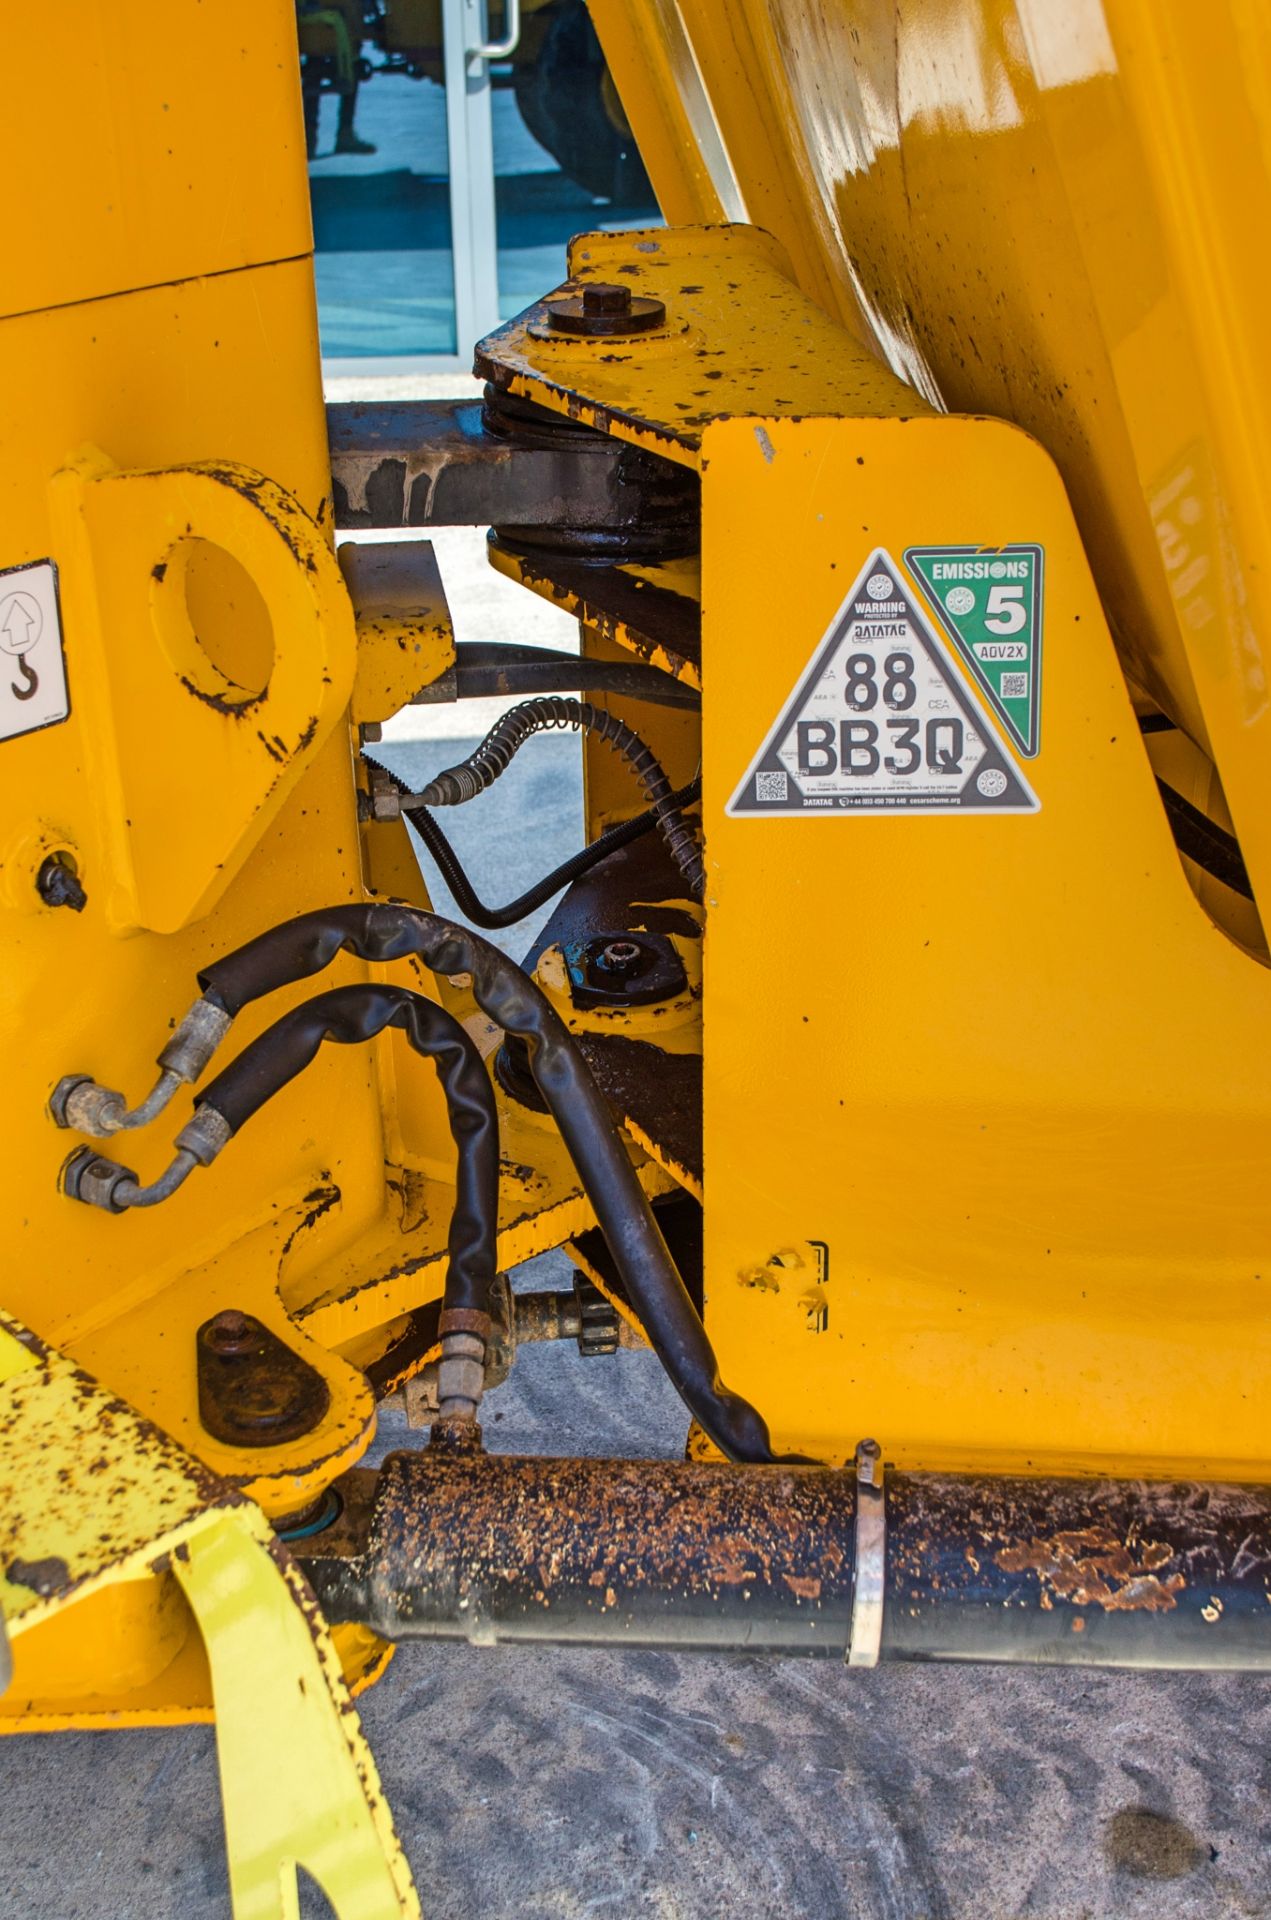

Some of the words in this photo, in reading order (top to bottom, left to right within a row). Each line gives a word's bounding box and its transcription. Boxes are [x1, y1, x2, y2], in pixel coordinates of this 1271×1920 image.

[932, 561, 1028, 579] EMISSIONS
[855, 602, 906, 614] WARNING
[984, 585, 1026, 635] 5
[855, 624, 906, 636] DATATAG
[844, 652, 917, 712] 88
[797, 718, 963, 777] BB3Q
[803, 798, 833, 806] DATATAG
